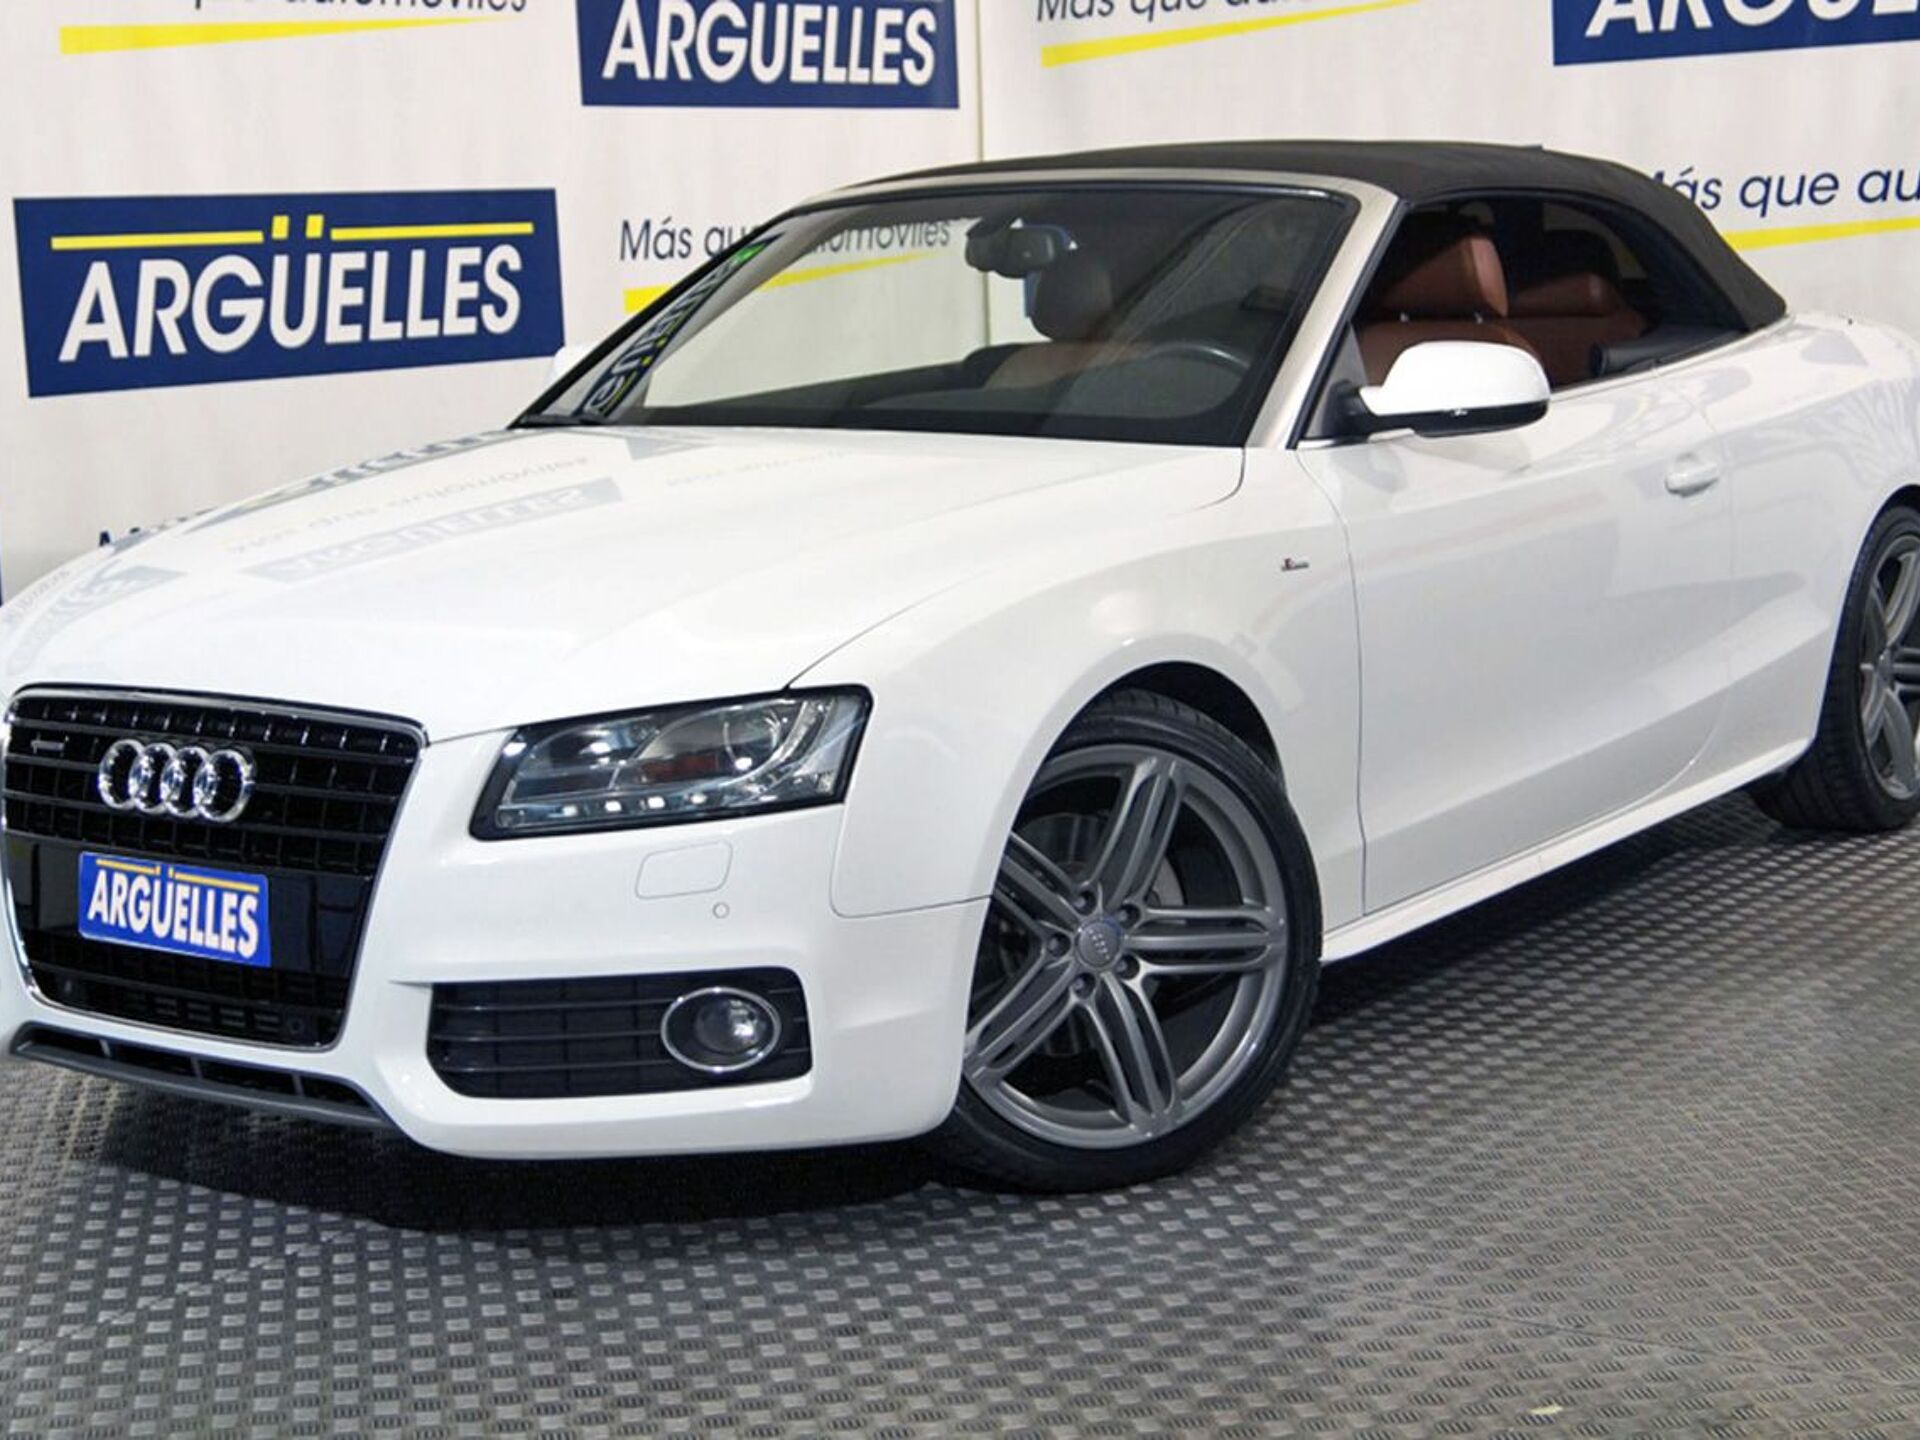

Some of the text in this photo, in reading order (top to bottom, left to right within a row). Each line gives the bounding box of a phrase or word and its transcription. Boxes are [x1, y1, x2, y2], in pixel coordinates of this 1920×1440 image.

[1653, 167, 1722, 210] ás
[1738, 175, 1839, 217] que
[620, 216, 692, 261] Más
[58, 214, 522, 363] ARGÜELLES
